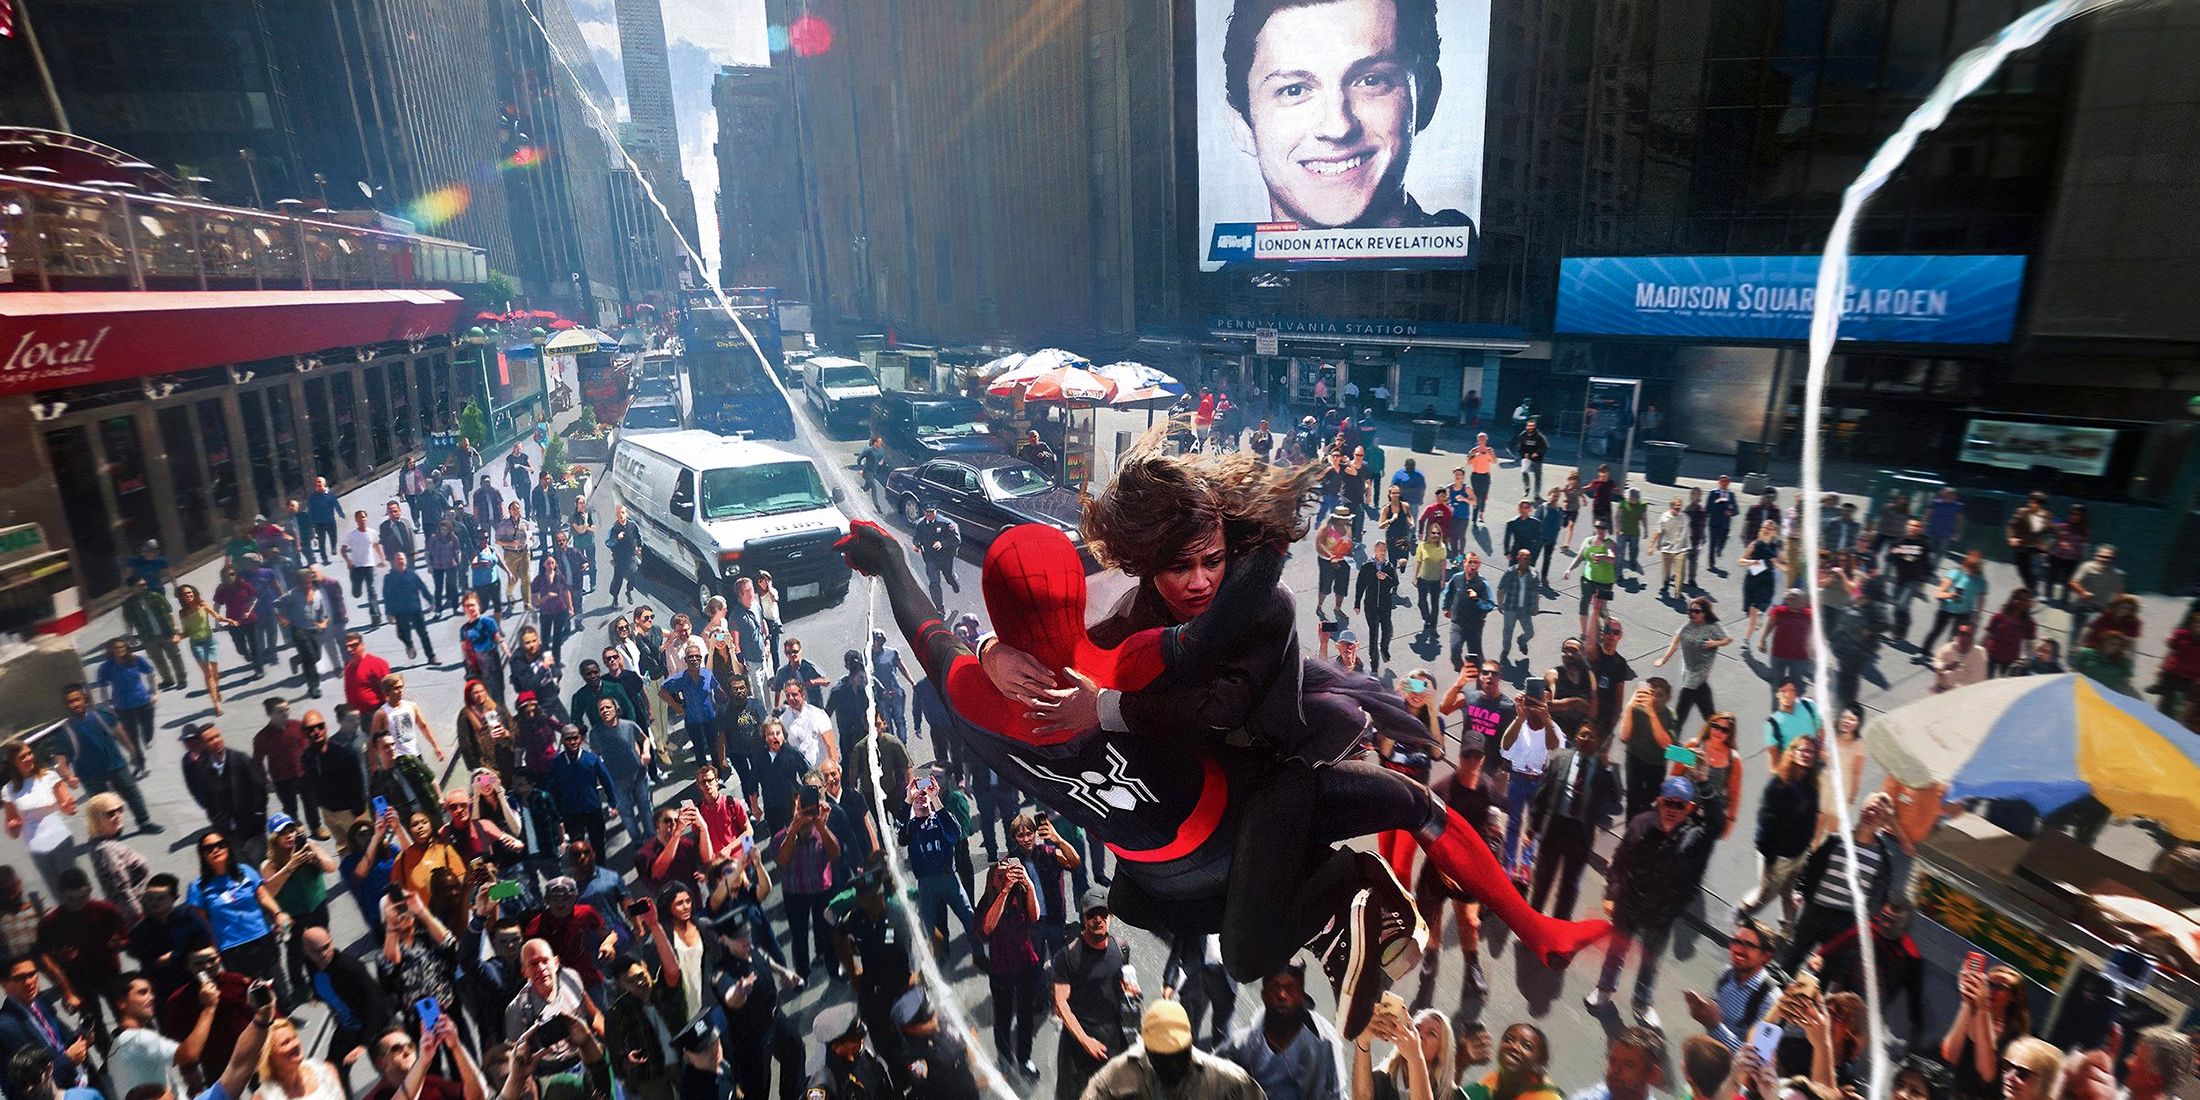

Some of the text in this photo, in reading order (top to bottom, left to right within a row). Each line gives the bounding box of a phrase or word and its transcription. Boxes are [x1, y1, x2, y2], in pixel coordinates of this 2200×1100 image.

[1258, 239, 1311, 251] LONDON
[1314, 237, 1363, 250] ATTACK
[1367, 235, 1464, 250] REVELATIONS
[1635, 282, 1948, 316] MADISON SQUAR GARDEN
[1217, 319, 1417, 335] PENNSYLVANIA STATION
[4, 326, 111, 370] local
[616, 451, 646, 480] POLICE
